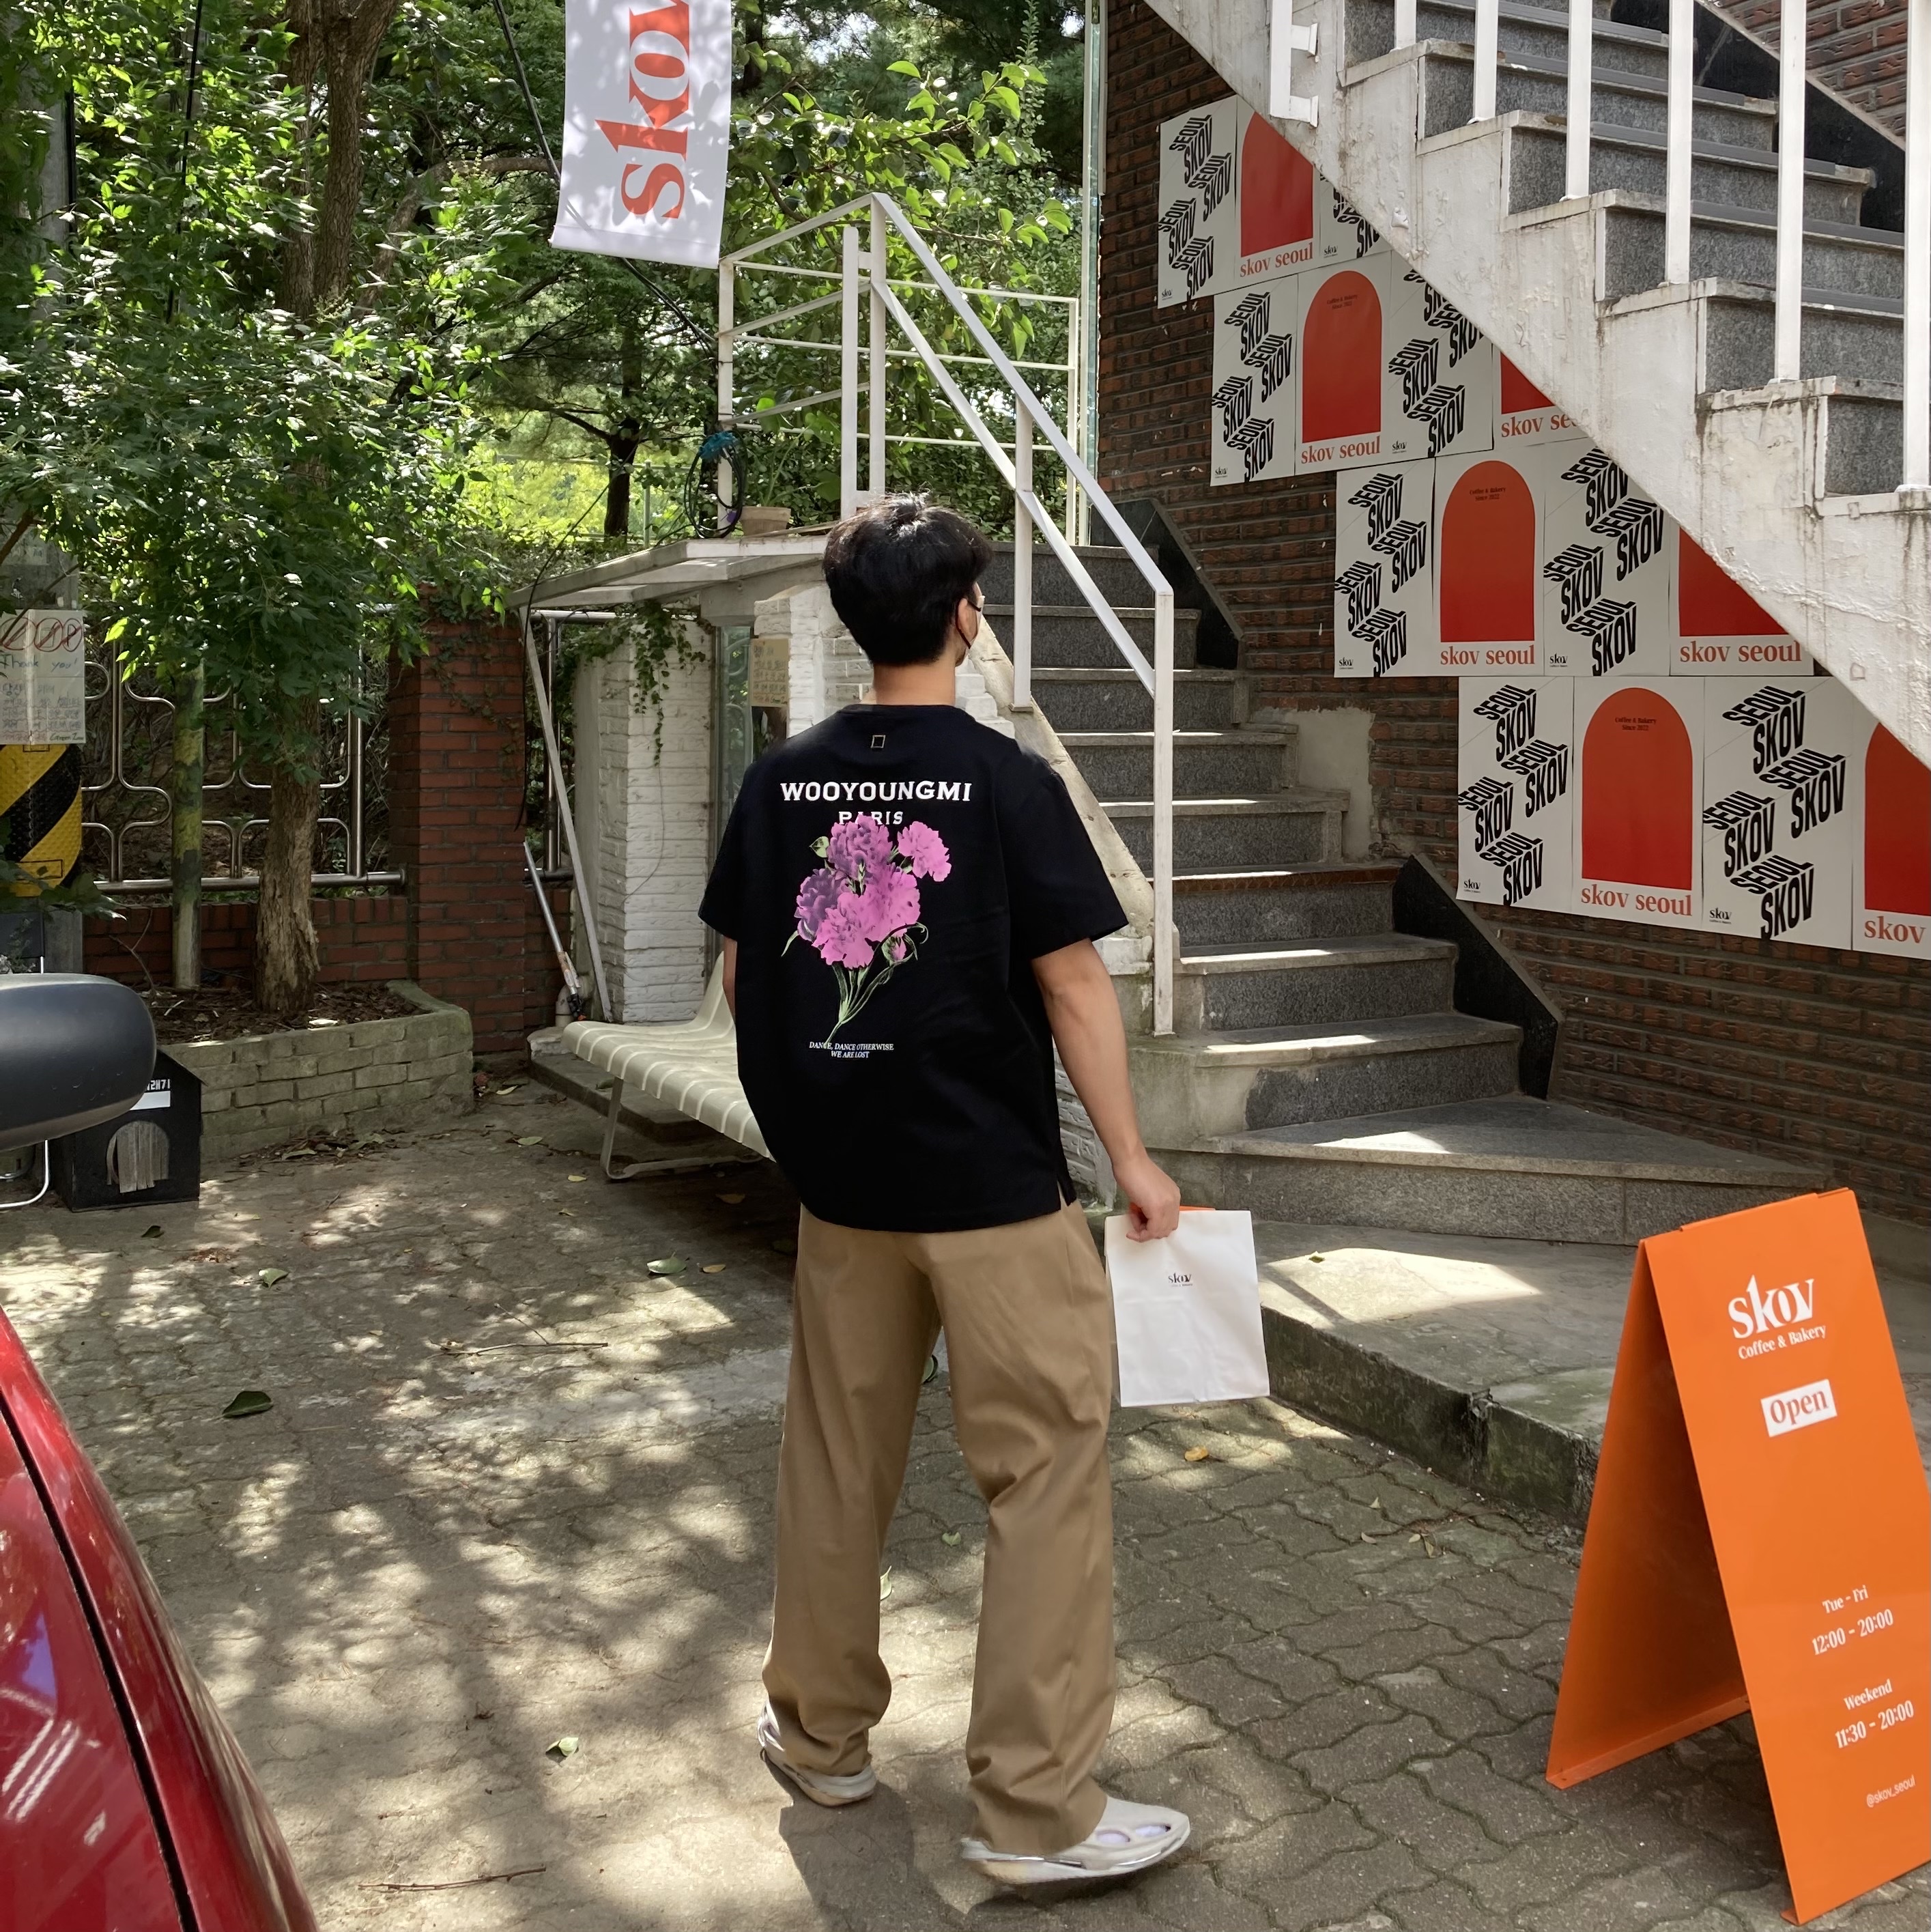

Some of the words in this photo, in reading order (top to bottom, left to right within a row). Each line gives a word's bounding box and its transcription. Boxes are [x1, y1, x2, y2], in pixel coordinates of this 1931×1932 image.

[1169, 115, 1212, 151] SEOUL
[1184, 117, 1212, 184] SKOV
[1188, 153, 1231, 188] SEOUL
[1203, 155, 1231, 222] SKOV
[1158, 198, 1196, 232] SEOUL
[1169, 200, 1196, 265] SKOV
[1171, 236, 1214, 270] SEOUL
[1187, 239, 1214, 300] SKOV
[1240, 257, 1271, 277] skov
[1275, 242, 1313, 268] seoul
[1224, 292, 1270, 326] SEOUL
[1240, 295, 1270, 360] SKOV
[1244, 334, 1291, 367] SEOUL
[1388, 338, 1438, 375] SEOUL
[1450, 317, 1484, 367] SKO
[1261, 337, 1292, 403] SKOV
[1403, 341, 1438, 414] SKOV
[1212, 376, 1253, 408] SEOUL
[1223, 379, 1253, 442] SKOV
[1407, 385, 1465, 421] SEOUL
[1227, 418, 1274, 450] SEOUL
[1428, 388, 1465, 457] SKOV
[1501, 416, 1544, 438] skov
[1244, 421, 1274, 483] SKOV
[1301, 445, 1335, 464] skov
[1339, 436, 1380, 459] seoul
[1347, 473, 1403, 507] SEOUL
[1586, 462, 1628, 527] SKOV
[1368, 477, 1403, 545] SKOV
[1371, 520, 1427, 554] SEOUL
[1617, 509, 1663, 581] SKOV
[1334, 560, 1382, 594] SEOUL
[1392, 524, 1427, 593] SKOV
[1543, 544, 1603, 582] SEOUL
[1348, 566, 1382, 631] SKOV
[1561, 550, 1603, 625] SKOV
[1351, 608, 1406, 642] SEOUL
[1566, 598, 1636, 636] SEOUL
[1373, 614, 1406, 677] SKOV
[1440, 646, 1480, 665] skov
[1486, 644, 1535, 664] seoul
[1550, 652, 1568, 664] skov
[1592, 606, 1636, 676] SKOV
[1680, 640, 1731, 662] skov
[1738, 640, 1802, 662] seoul
[0, 654, 38, 669] Thank
[1473, 684, 1536, 720] SEOUL
[1722, 685, 1805, 726] SEOUL
[1496, 693, 1536, 762] SKOV
[1754, 696, 1805, 774] SKOV
[1501, 739, 1568, 775] SEOUL
[1759, 749, 1846, 790] SEOUL
[780, 780, 972, 801] WOOYOUNGMI
[1458, 776, 1513, 811] SEOUL
[1526, 748, 1568, 818] SKOV
[1791, 760, 1846, 838] SKOV
[1475, 786, 1513, 853] SKOV
[1703, 791, 1775, 830] SEOUL
[1479, 832, 1543, 867] SEOUL
[1724, 802, 1775, 877] SKOV
[1464, 879, 1481, 890] skov
[1504, 842, 1543, 906] SKOV
[1730, 855, 1814, 894] SEOUL
[1581, 884, 1629, 907] skov
[1635, 894, 1692, 916] seoul
[1710, 907, 1732, 920] skov
[1761, 868, 1814, 939] SKOV
[1865, 915, 1926, 944] skov
[1168, 1273, 1192, 1283] skov
[1728, 1275, 1814, 1339] skov
[1738, 1339, 1776, 1360] Coffee
[1777, 1335, 1786, 1348] &
[1789, 1325, 1827, 1345] Bakery
[1770, 1389, 1829, 1425] Open
[1822, 1595, 1844, 1614] Tue
[1853, 1585, 1869, 1603] Fri
[1812, 1628, 1846, 1656] 12:00
[1857, 1608, 1893, 1637] 20:00
[1844, 1679, 1893, 1710] Weekend
[1835, 1721, 1867, 1748] 11:30
[1878, 1700, 1915, 1731] 20:00
[1866, 1774, 1916, 1808] @skov_seoul
